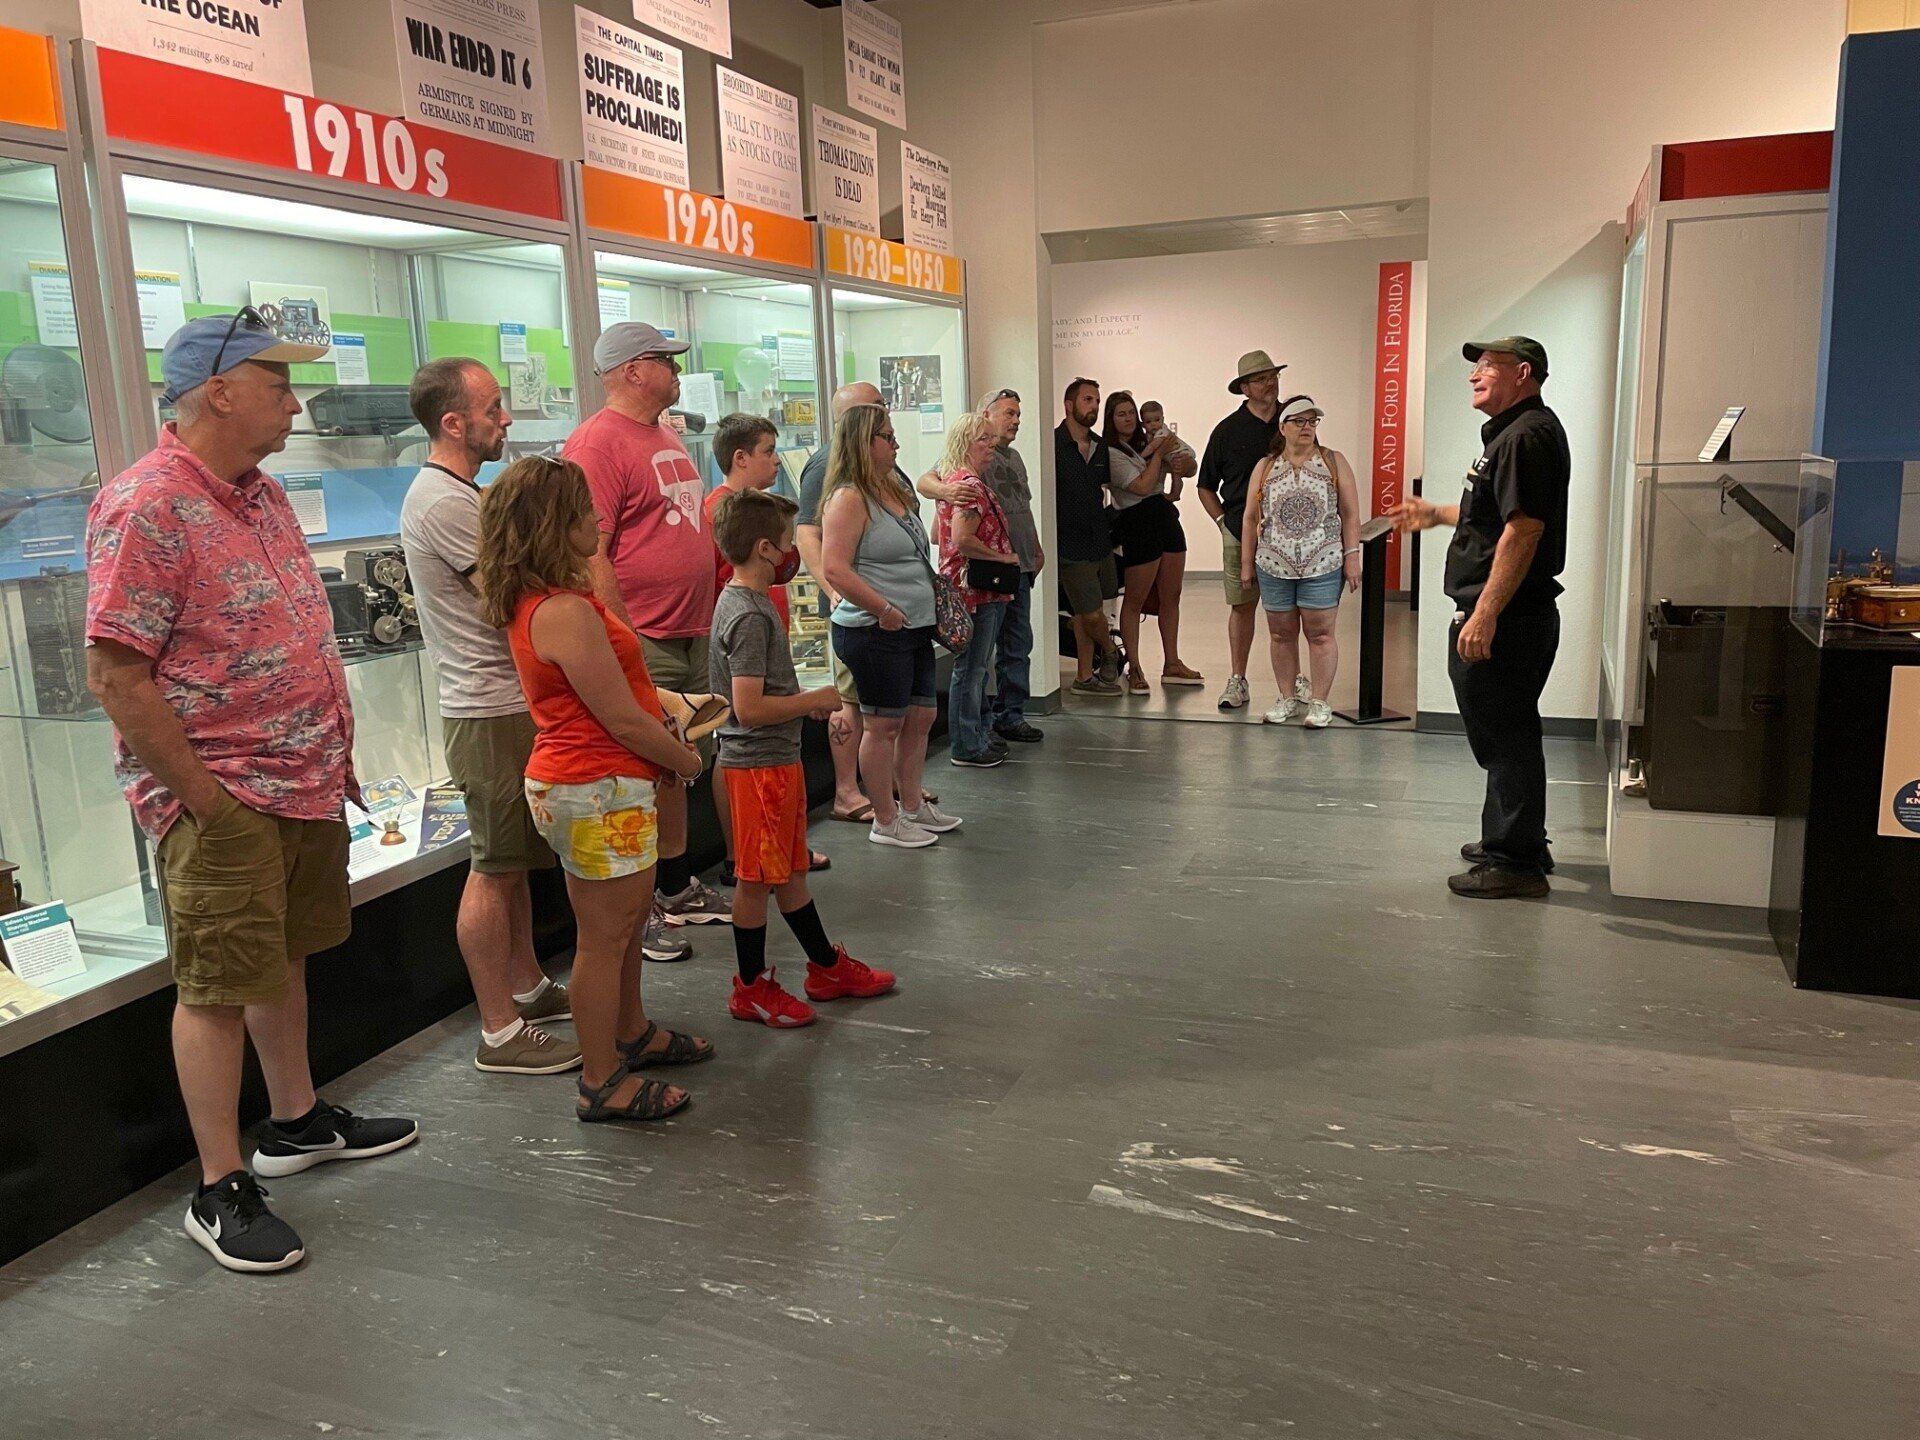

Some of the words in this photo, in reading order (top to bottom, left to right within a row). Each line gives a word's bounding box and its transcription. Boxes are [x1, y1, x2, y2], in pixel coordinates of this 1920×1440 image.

[187, 0, 260, 37] OCEAN
[498, 2, 526, 22] PRESS
[178, 46, 212, 64] missing,
[214, 54, 230, 66] 868
[232, 58, 254, 72] saved
[406, 17, 446, 64] WAR
[449, 32, 496, 78] ENDED
[501, 49, 516, 86] AT
[522, 58, 532, 90] 6
[598, 26, 612, 42] THE
[615, 33, 642, 53] CAPITAL
[644, 45, 664, 62] TIMES
[584, 52, 664, 105] SUFFRAGE
[668, 84, 680, 111] IS
[723, 72, 754, 96] BROOKLYN
[756, 86, 772, 104] DAILY
[775, 94, 793, 112] EAGLE
[418, 82, 474, 110] ARMISTICE
[480, 100, 515, 120] SIGNED
[522, 111, 533, 126] BY
[420, 102, 470, 126] GERMANS
[474, 118, 486, 130] AT
[487, 119, 535, 143] MIDNIGHT
[586, 89, 684, 144] PROCLAIMED!
[724, 110, 749, 134] WALL
[750, 120, 762, 138] ST.
[762, 124, 772, 140] IN
[774, 128, 796, 150] PANIC
[822, 116, 832, 128] FORT
[832, 120, 845, 133] MYERS
[283, 94, 450, 198] 1910s
[588, 150, 604, 164] FINAL
[605, 154, 626, 168] VICTORY
[639, 164, 662, 180] AMERICAN
[600, 136, 628, 152] SECRETARY
[642, 148, 656, 160] STATE
[727, 134, 737, 152] AS
[740, 139, 771, 164] STOCKS
[772, 150, 798, 173] CRASH
[818, 139, 848, 169] THOMAS
[850, 151, 874, 178] EDISON
[906, 147, 915, 160] The
[915, 150, 937, 168] Dearborn
[937, 160, 950, 174] Press
[834, 176, 842, 197] IS
[843, 178, 862, 203] DEAD
[910, 175, 930, 196] Dearborn
[932, 183, 946, 201] Stilled
[926, 196, 947, 217] Mourning
[662, 188, 756, 258] 1920s
[910, 205, 918, 219] for
[920, 208, 934, 229] Henry
[937, 213, 947, 228] Ford
[1100, 315, 1130, 323] EXPECT
[1384, 272, 1404, 346] FLORIDA
[1384, 353, 1400, 374] IN
[1382, 379, 1400, 428] FORD
[1380, 434, 1396, 475] AND
